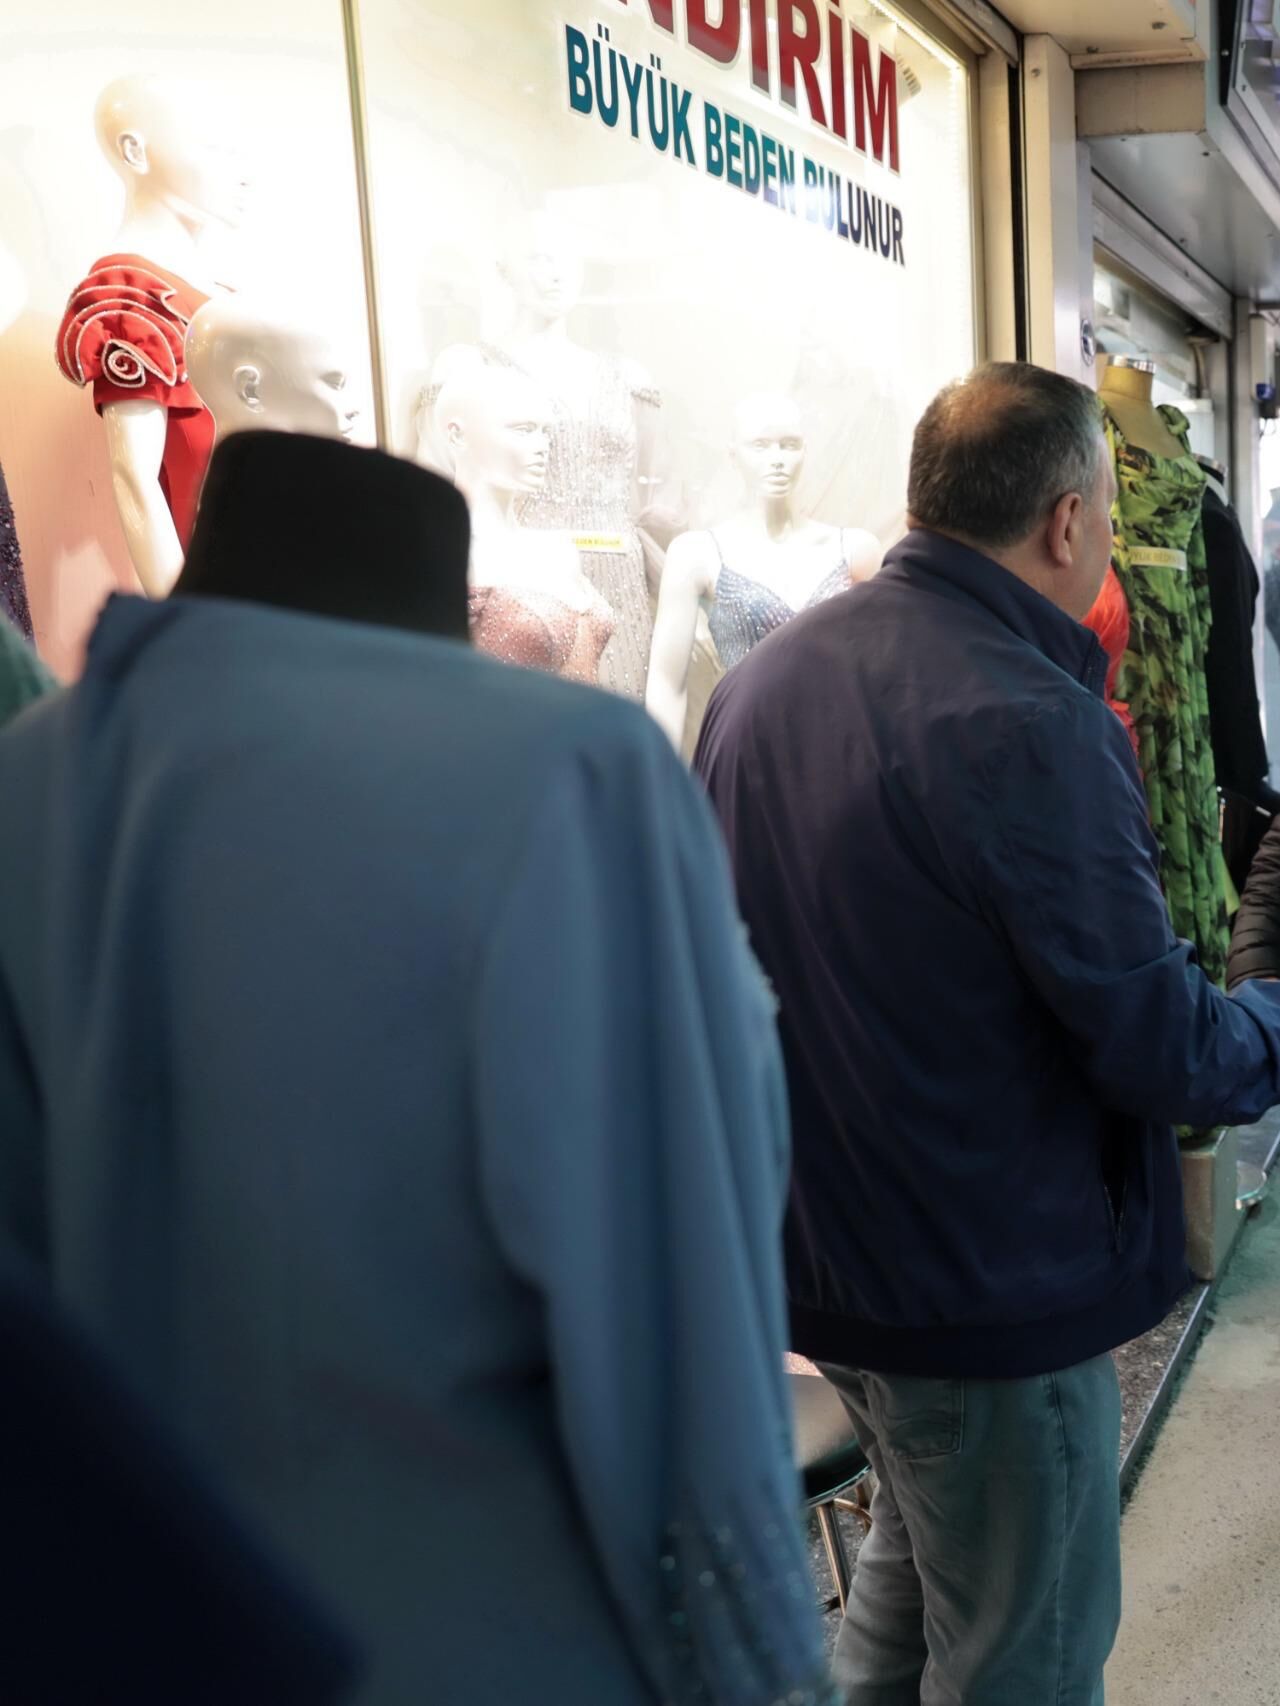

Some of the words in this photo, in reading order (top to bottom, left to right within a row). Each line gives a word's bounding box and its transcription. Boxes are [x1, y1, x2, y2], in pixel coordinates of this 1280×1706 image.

[565, 23, 696, 166] BÜYÜK
[704, 101, 796, 215] BEDEN
[803, 157, 905, 266] BULUNUR
